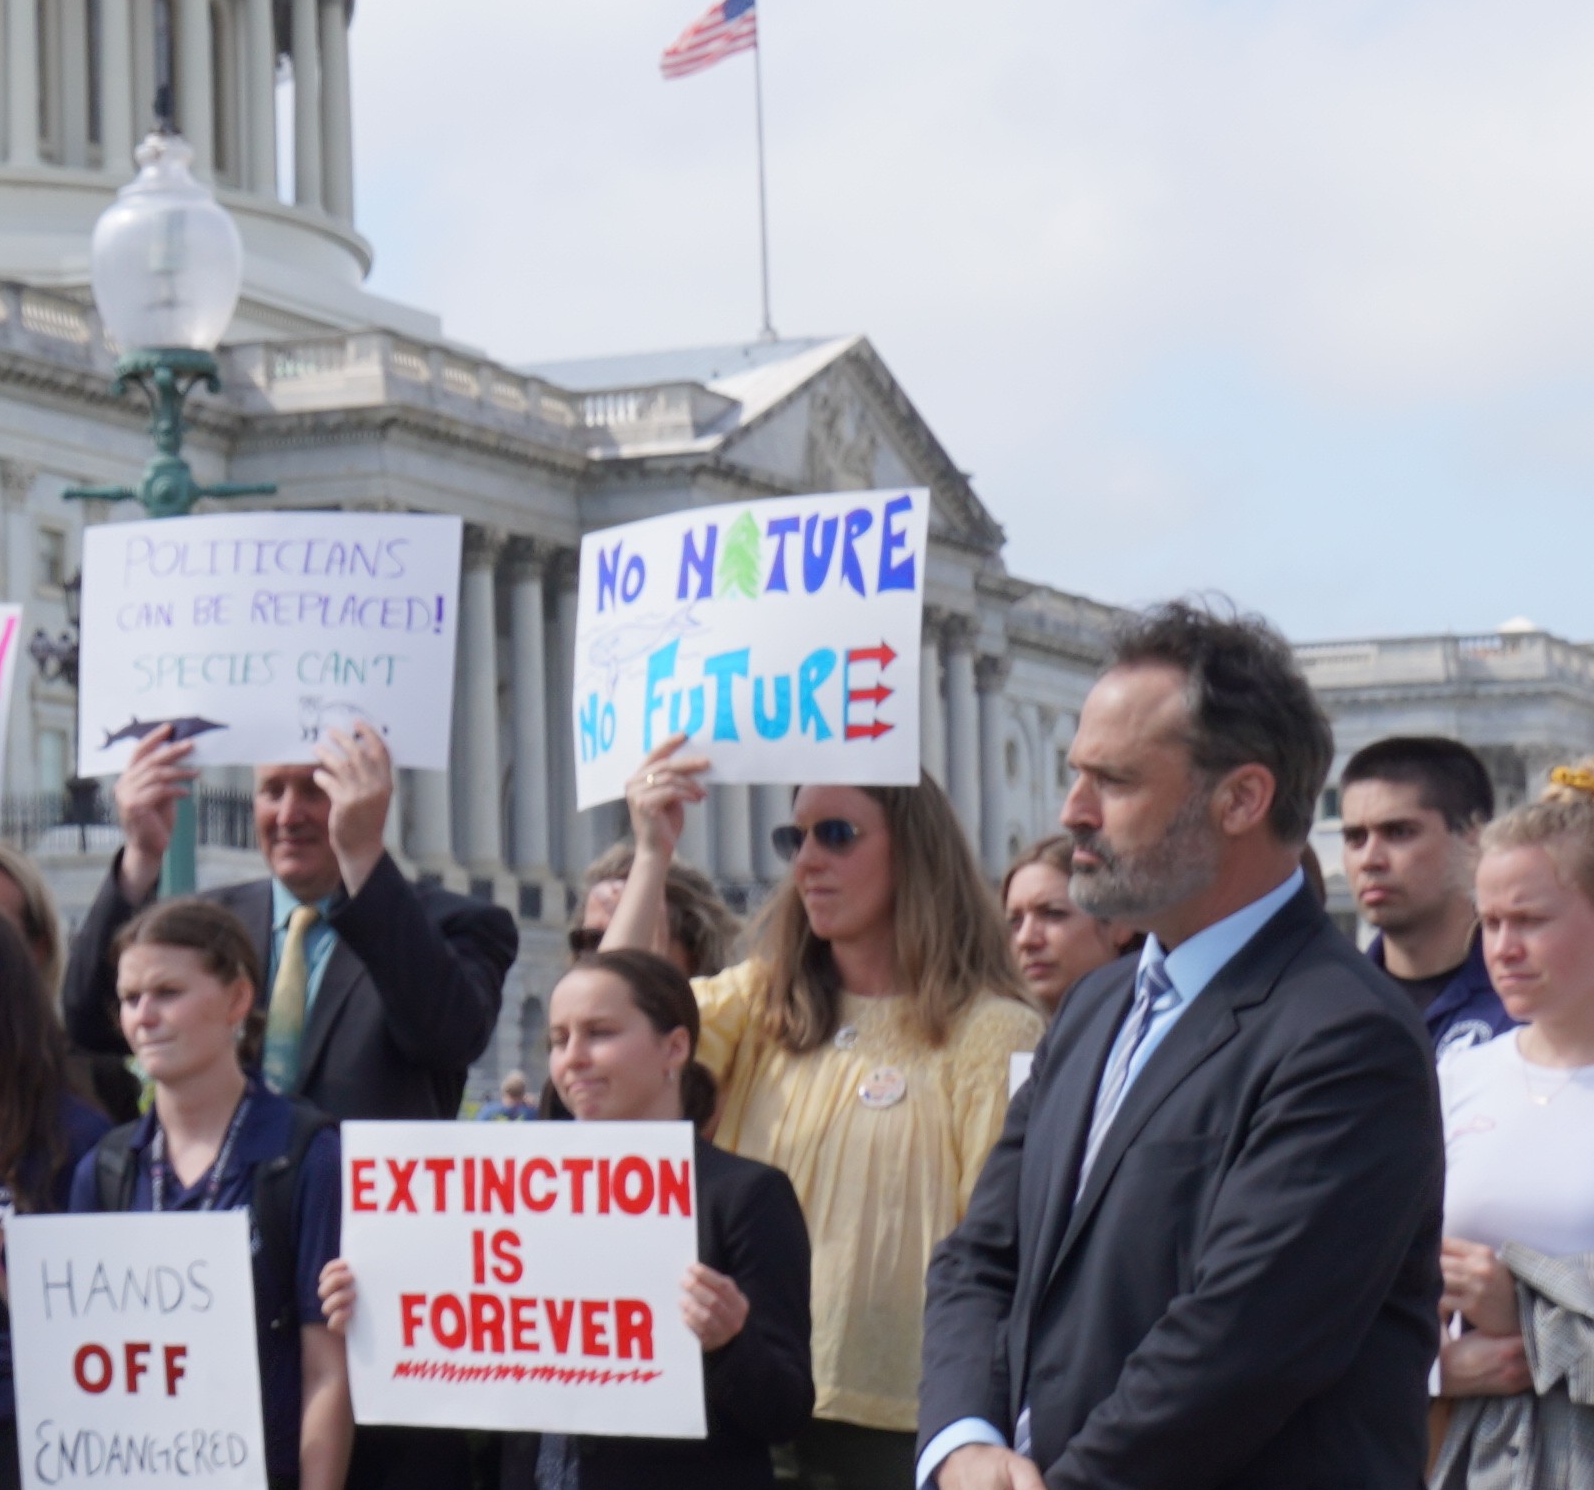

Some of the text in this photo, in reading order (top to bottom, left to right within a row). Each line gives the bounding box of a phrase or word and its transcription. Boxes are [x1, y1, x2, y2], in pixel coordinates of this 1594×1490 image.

[123, 536, 411, 588] POLITICIANS
[597, 540, 646, 614] NO
[117, 589, 444, 635] CAN BE REPLACED!
[133, 650, 281, 694] SPECIES
[580, 636, 899, 762] NO FUTURE
[350, 1154, 692, 1218] EXTINCTION
[471, 1228, 525, 1285] IS
[40, 1259, 215, 1320] HANDS
[400, 1292, 655, 1361] FOREVER
[72, 1341, 189, 1397] OFF
[34, 1418, 250, 1486] ENDANGERED
